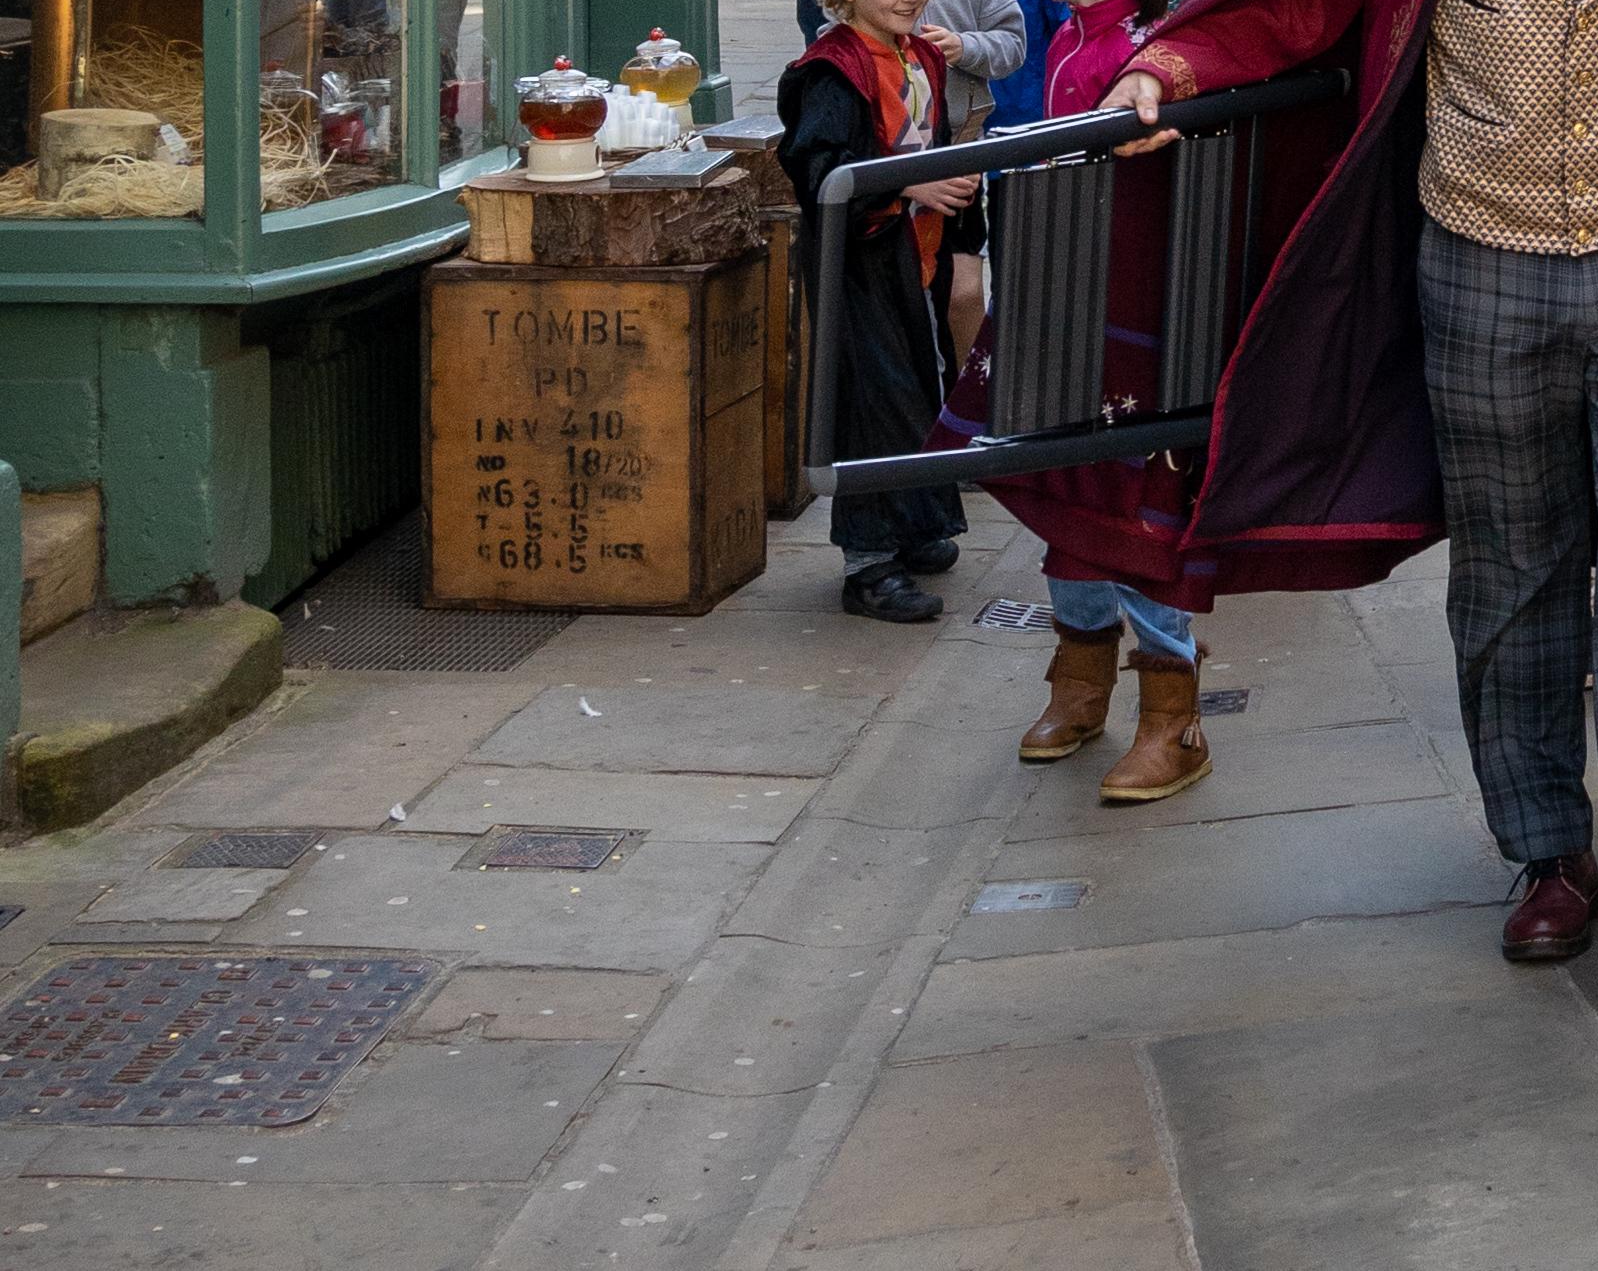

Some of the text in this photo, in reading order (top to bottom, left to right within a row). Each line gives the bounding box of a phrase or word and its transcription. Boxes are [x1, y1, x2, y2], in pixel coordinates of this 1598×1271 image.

[481, 308, 641, 347] TOMBE
[534, 367, 588, 398] PD
[475, 409, 624, 443] INV 410
[475, 454, 506, 472] NO
